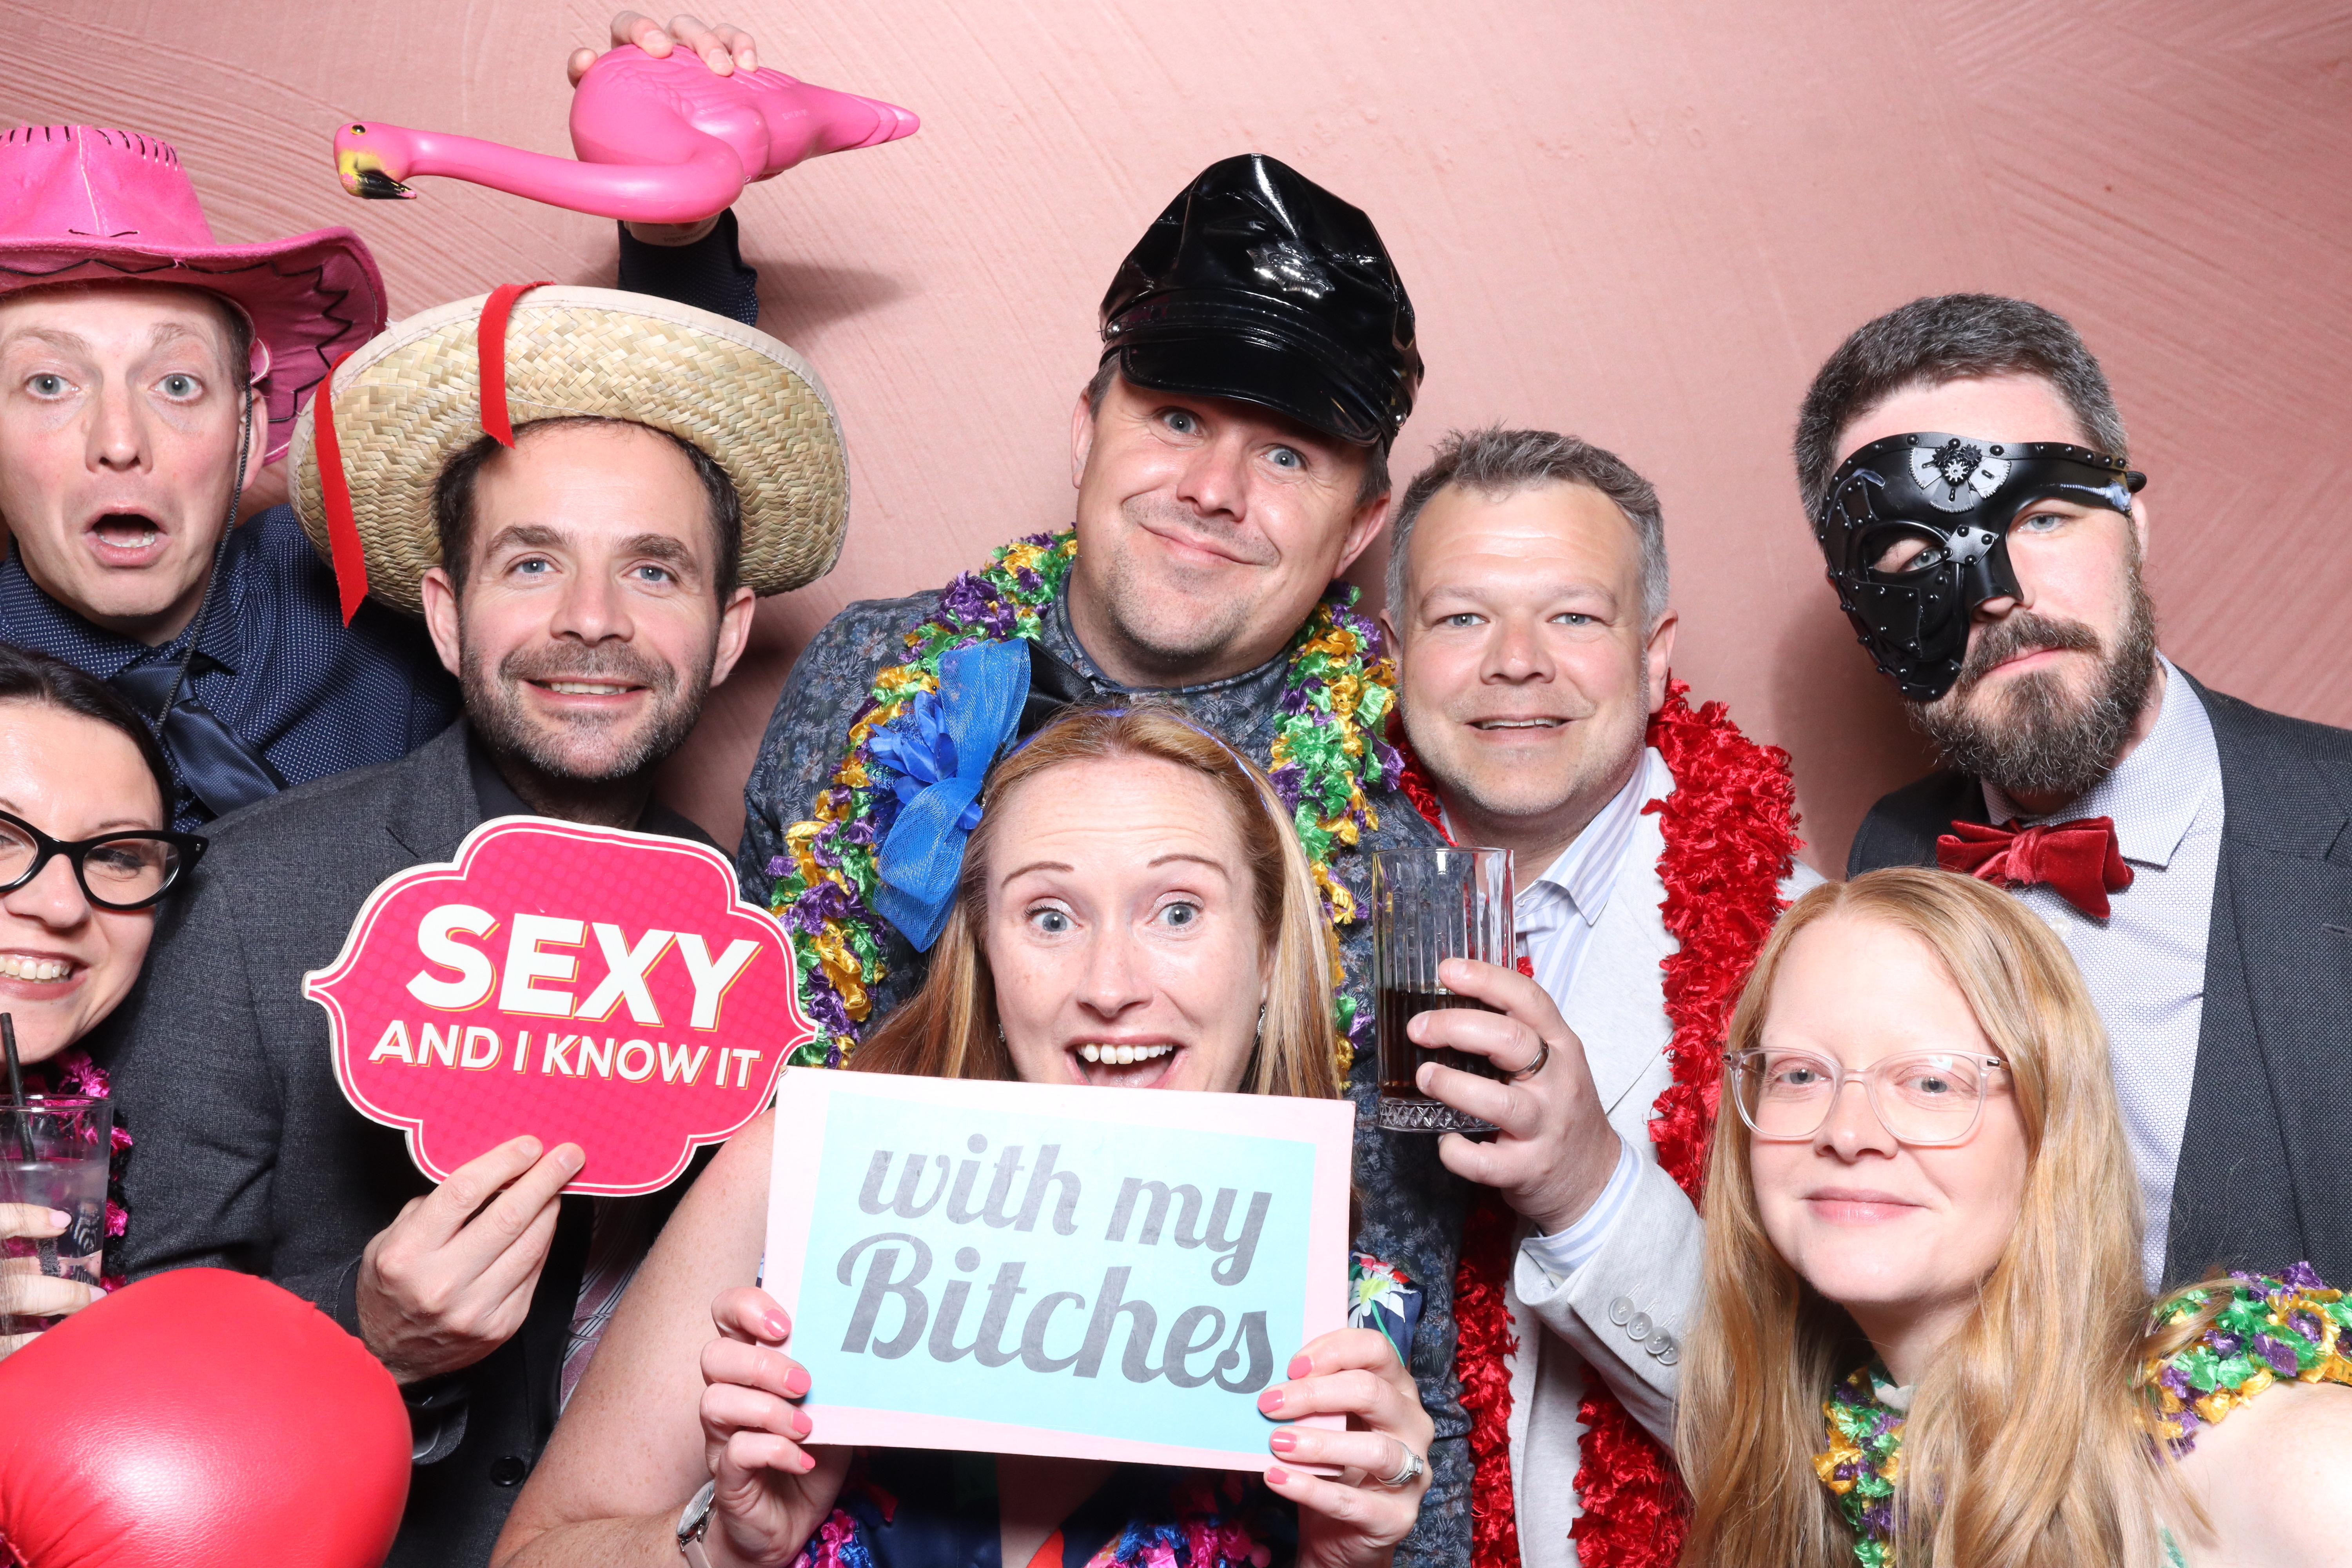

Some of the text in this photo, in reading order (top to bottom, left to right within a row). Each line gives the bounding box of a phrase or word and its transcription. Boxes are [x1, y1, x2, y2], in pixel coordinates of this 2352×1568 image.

[405, 904, 763, 1032] SEXY
[368, 1019, 763, 1090] AND I KNOW IT
[858, 1134, 1272, 1286] with my
[836, 1232, 1274, 1394] Bitches
